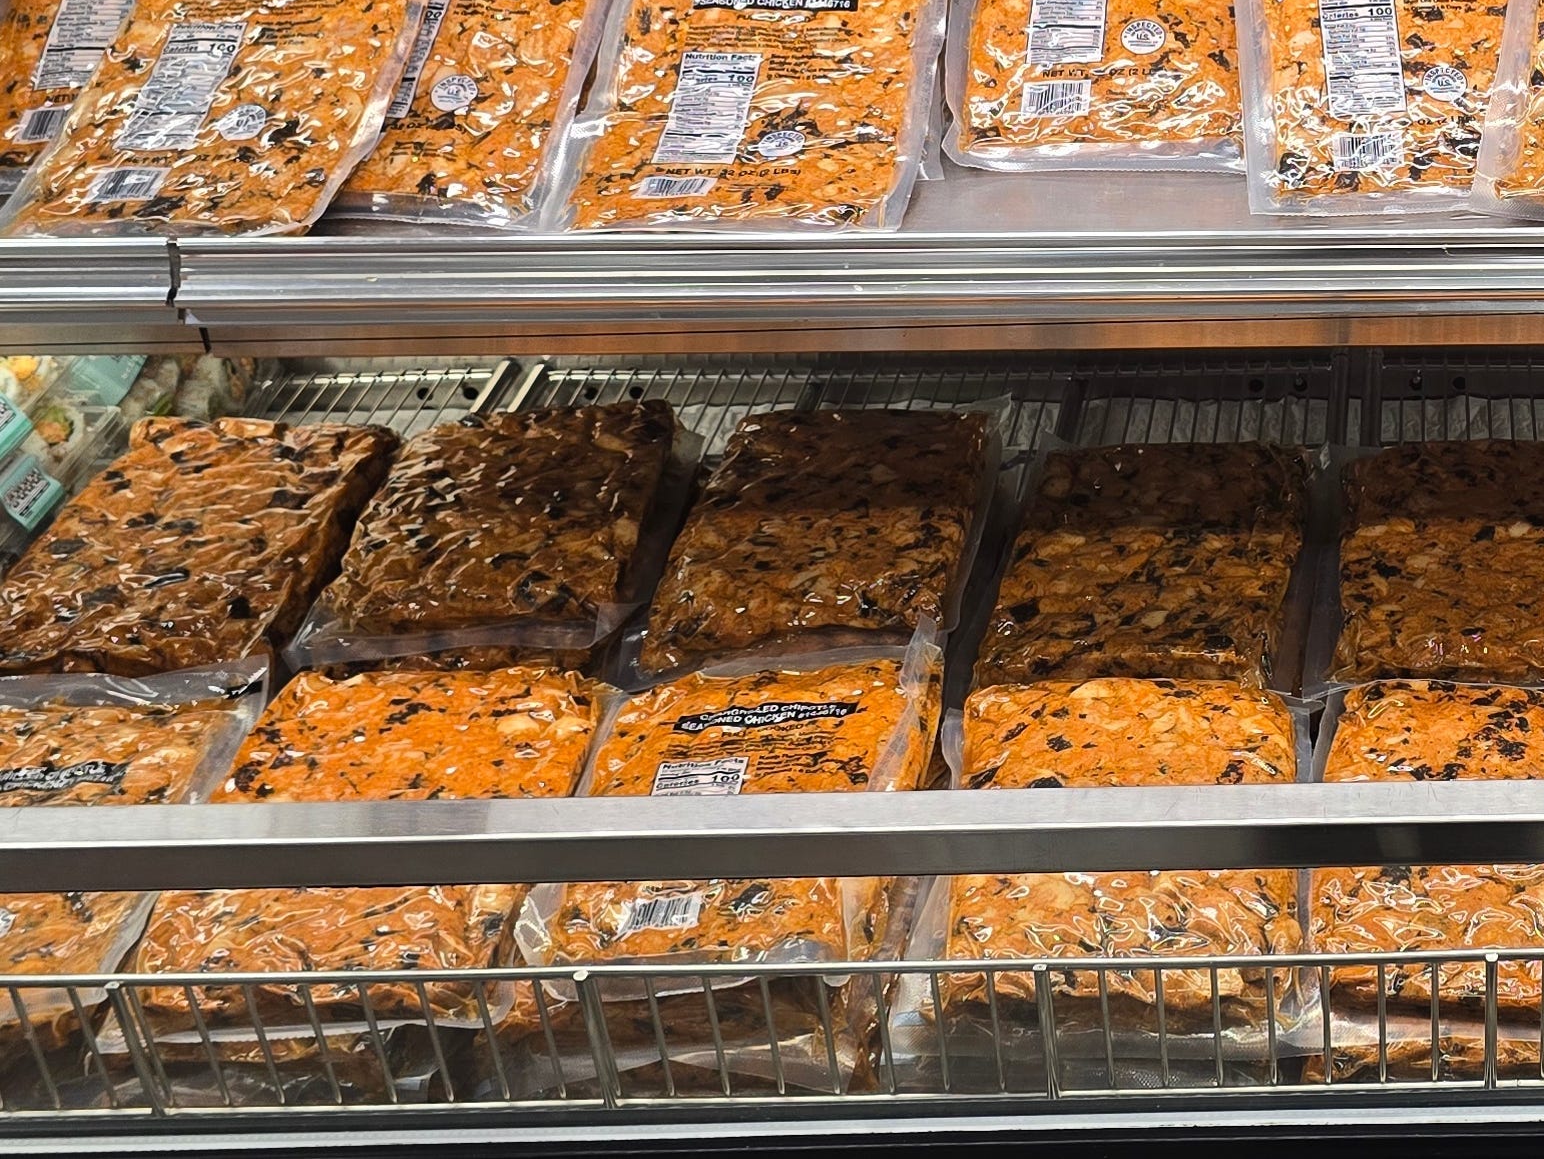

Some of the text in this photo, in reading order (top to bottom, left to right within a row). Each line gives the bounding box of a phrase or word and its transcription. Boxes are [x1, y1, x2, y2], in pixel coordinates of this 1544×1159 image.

[1368, 7, 1393, 16] 100
[727, 74, 755, 84] 100
[711, 773, 740, 783] 100
